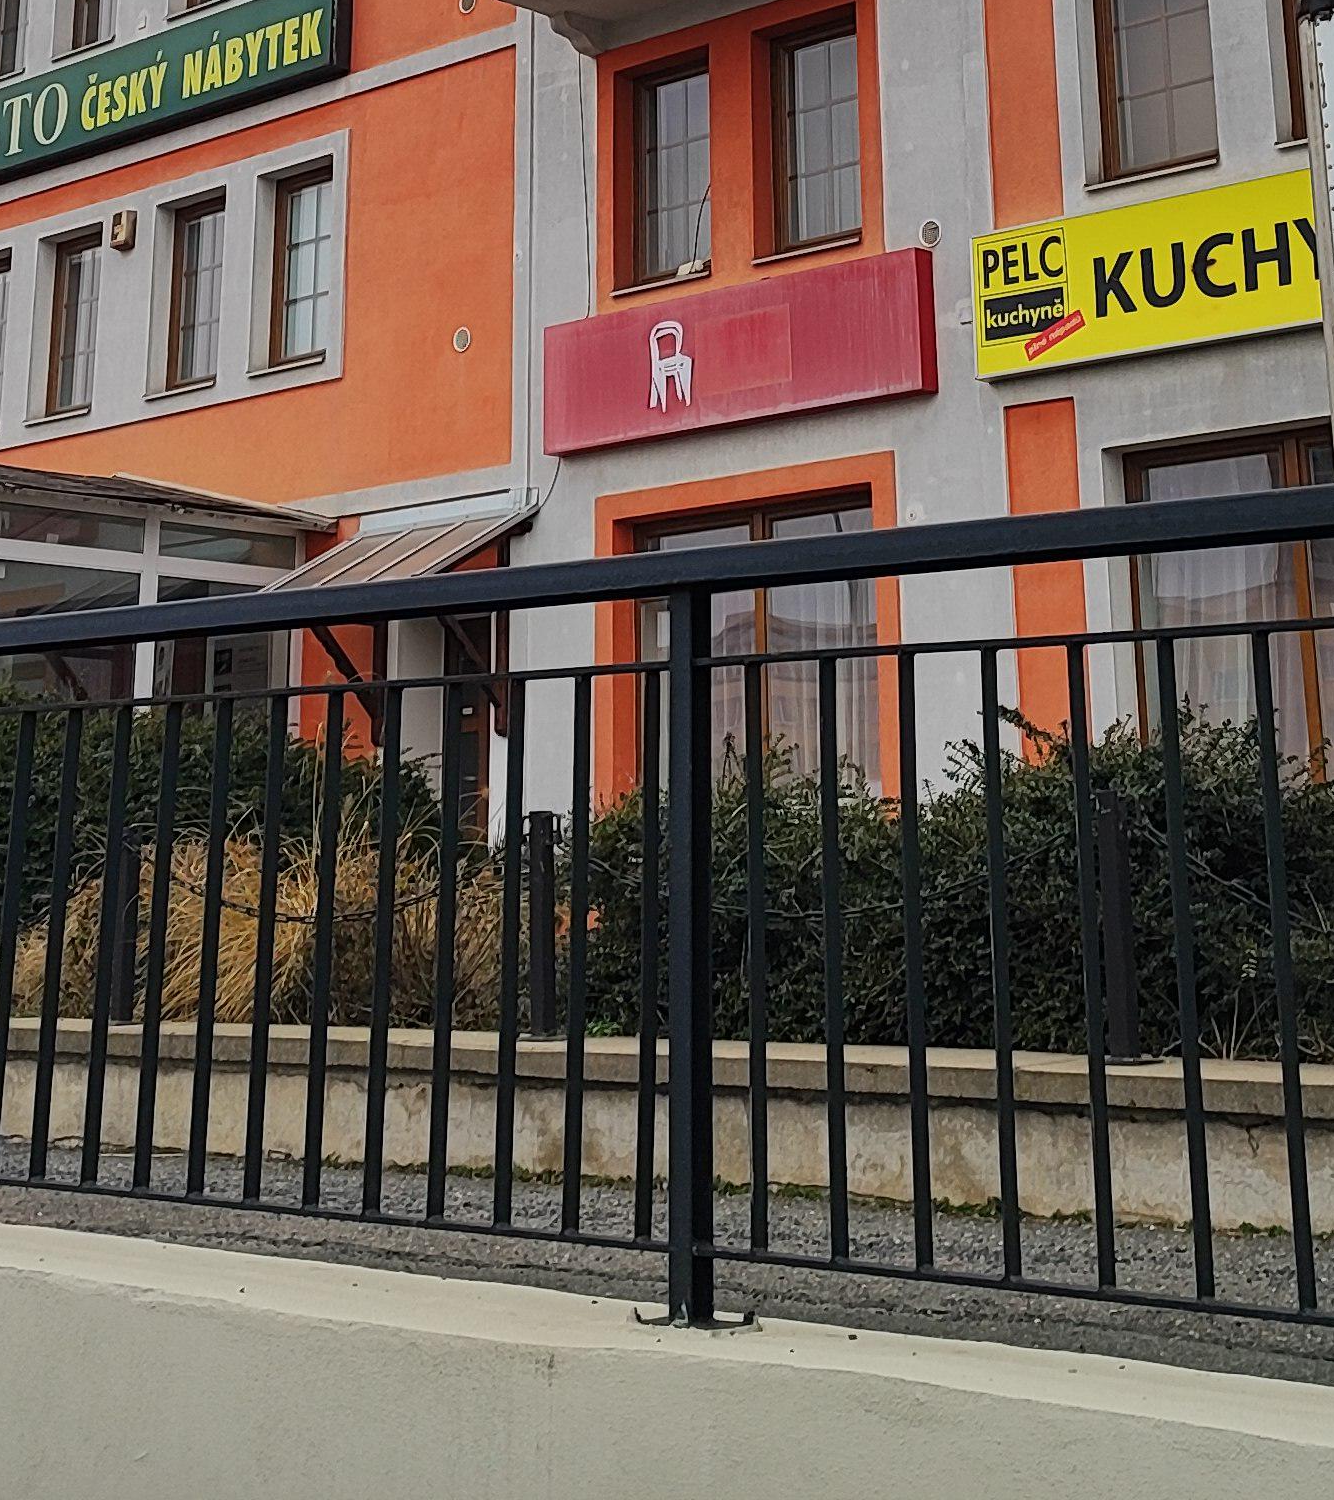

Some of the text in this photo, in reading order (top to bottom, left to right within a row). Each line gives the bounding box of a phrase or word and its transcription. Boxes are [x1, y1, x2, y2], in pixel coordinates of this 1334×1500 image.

[80, 50, 168, 131] ČESKÝ
[181, 8, 324, 100] NÁBYTEK
[982, 235, 1064, 289] PELC
[986, 298, 1064, 328] kuchyně
